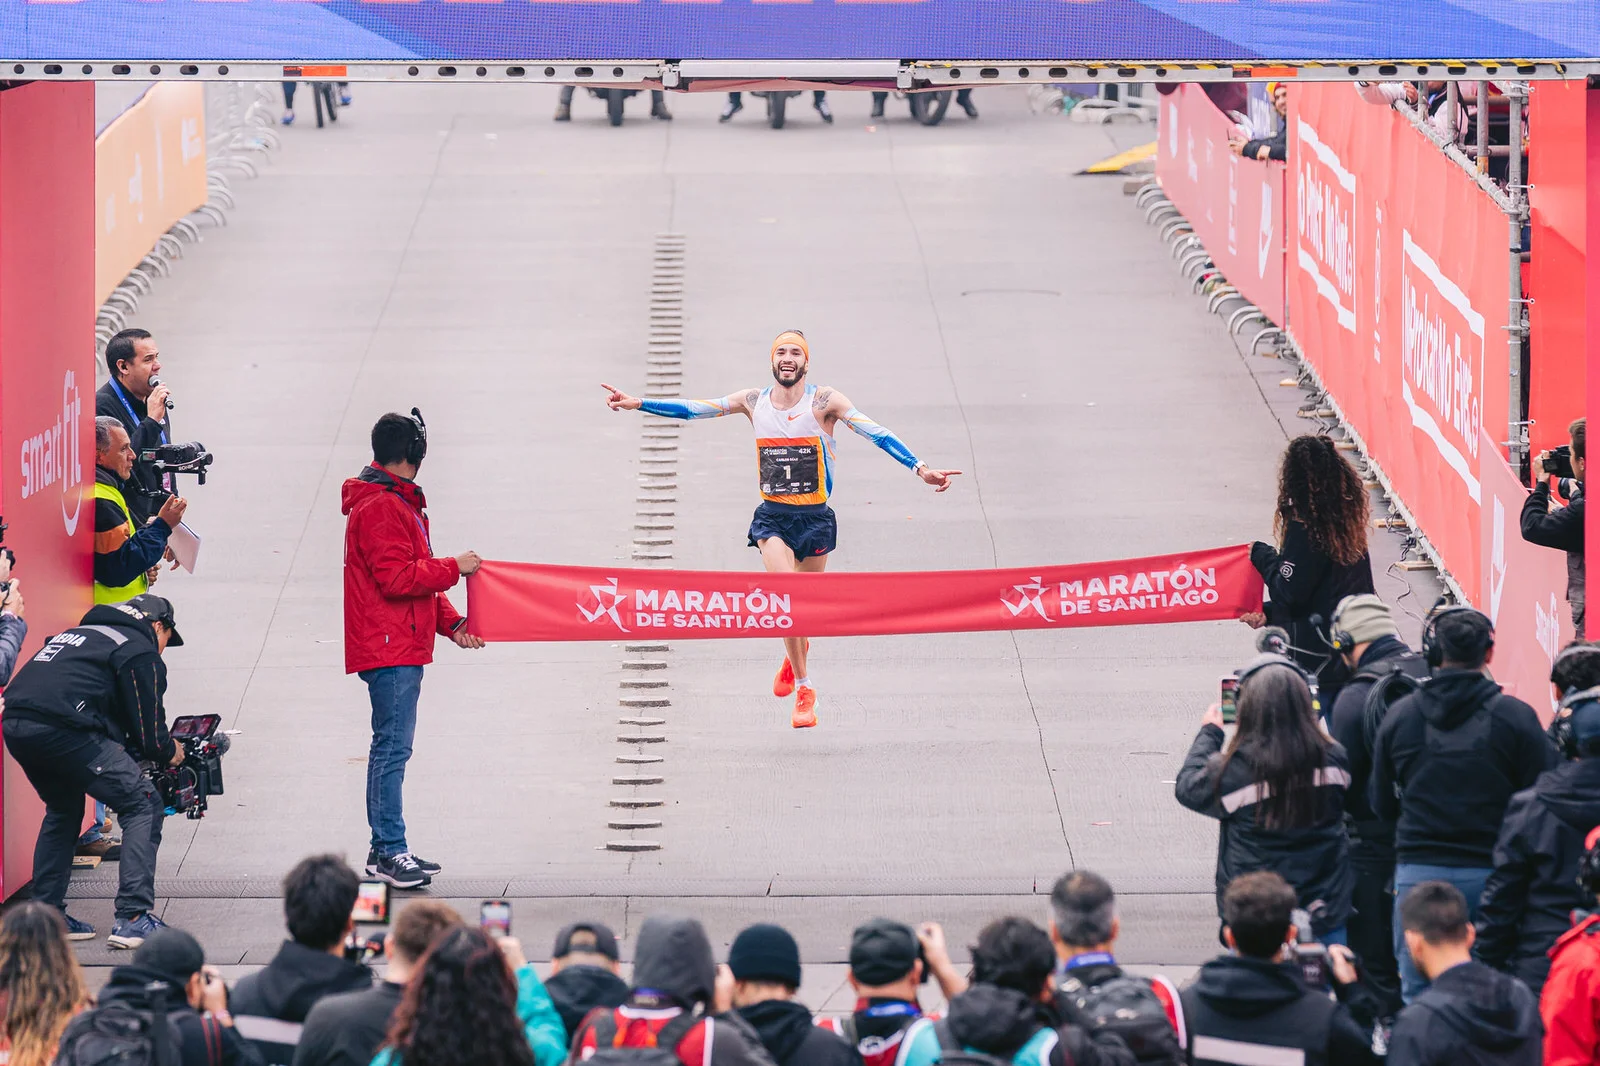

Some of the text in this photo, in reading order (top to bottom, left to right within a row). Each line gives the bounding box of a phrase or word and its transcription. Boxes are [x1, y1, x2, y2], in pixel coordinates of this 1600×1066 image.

[783, 465, 791, 480] 1
[1059, 563, 1216, 599] MARATÓN
[635, 587, 791, 613] MARATÓN
[1061, 588, 1219, 616] DE SANTIAGO
[636, 614, 793, 629] DE SANTIAGO
